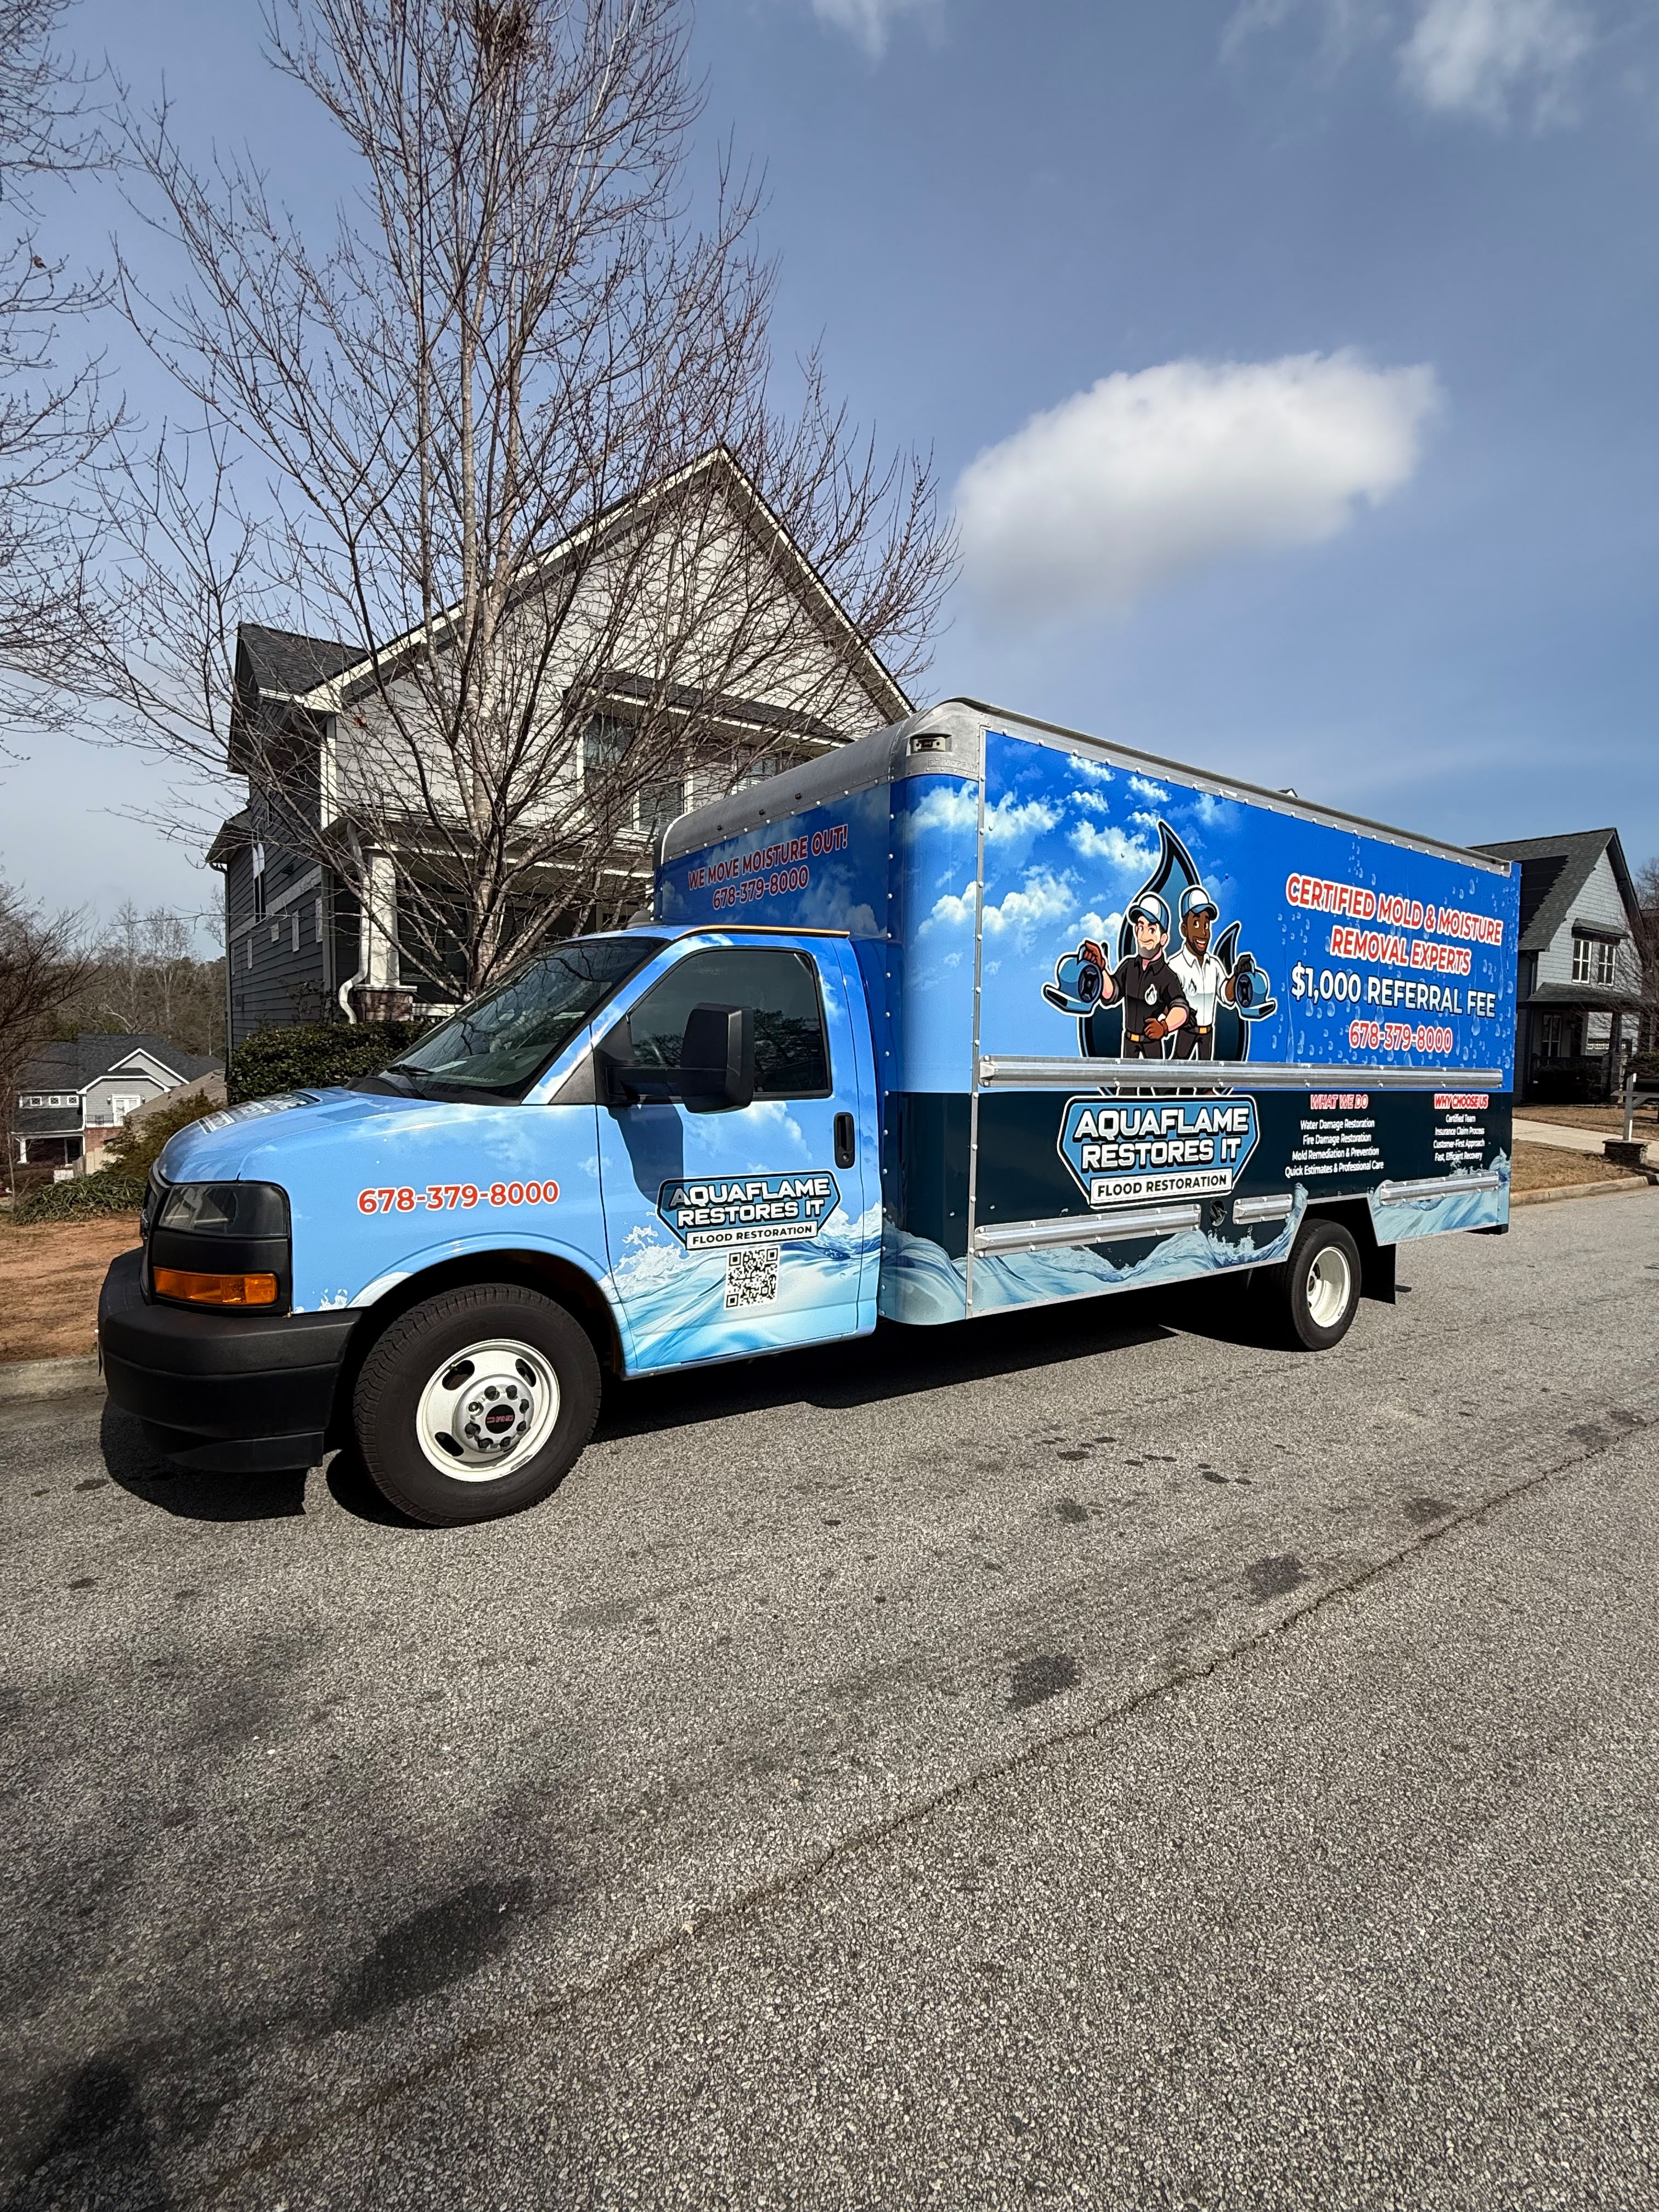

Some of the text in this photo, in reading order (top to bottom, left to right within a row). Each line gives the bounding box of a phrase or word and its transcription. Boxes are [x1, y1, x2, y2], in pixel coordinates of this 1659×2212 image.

[688, 824, 849, 891] WE MOVE MOISTURE OUT!
[713, 865, 809, 910] 678-379-8000
[1285, 873, 1503, 946] CERTIFIED MOLD & MOISTURE
[1330, 926, 1471, 976] REMOVAL EXPERTS
[1290, 961, 1497, 1018] $1,000 REFERRAL FEE
[1348, 1019, 1453, 1054] 678-379-8000
[1310, 1094, 1369, 1110] WHAT WE DO
[1434, 1093, 1489, 1109] WHY CHOOSE US
[1074, 1108, 1249, 1141] AQUAFLAME
[1300, 1118, 1375, 1131] Water Damage Restoration
[1302, 1132, 1372, 1146] Fire Damage Restoration
[1082, 1137, 1242, 1170] RESTORES IT
[1291, 1146, 1379, 1161] Mold Remediation & Prevention
[1285, 1160, 1384, 1178] Quick Estimates & Professional Care
[357, 1180, 560, 1215] 678-379-8000
[670, 1178, 831, 1207] AQUAFLAME
[1097, 1174, 1227, 1198] FLOOD RESTORATION
[678, 1199, 825, 1227] RESTORES IT
[692, 1225, 812, 1245] FLOOD RESTORATION
[487, 1415, 514, 1424] GMC
